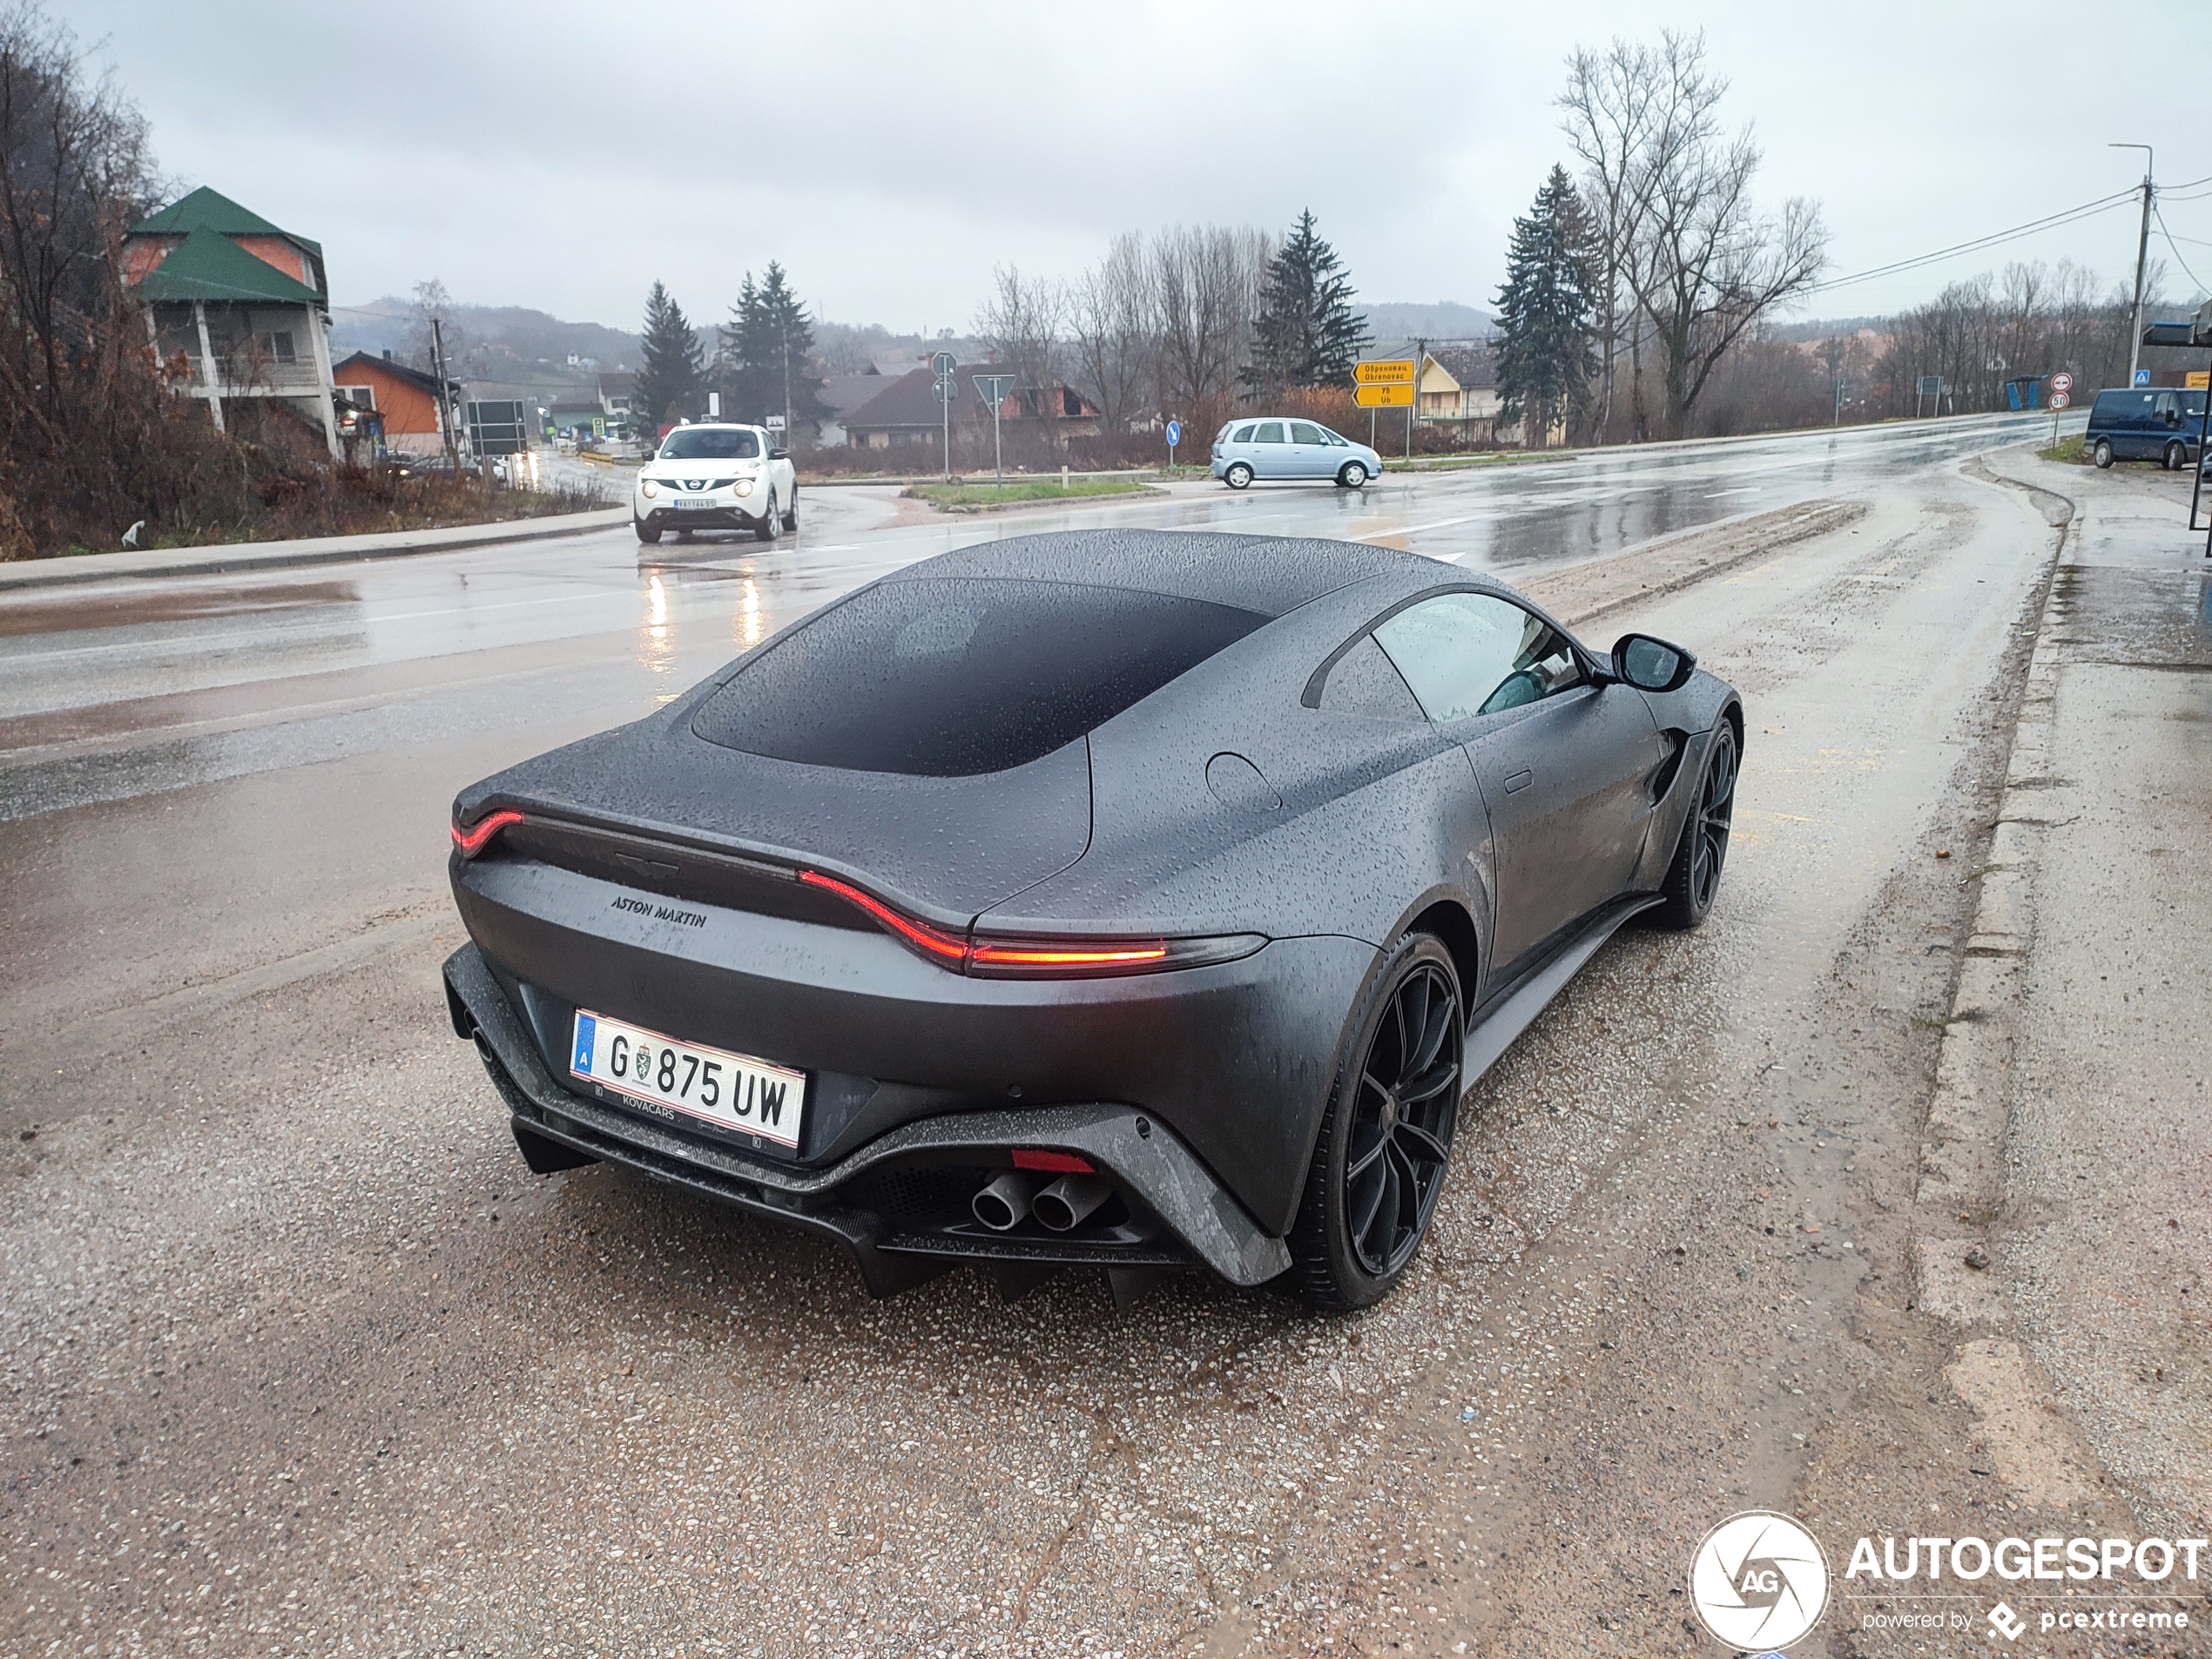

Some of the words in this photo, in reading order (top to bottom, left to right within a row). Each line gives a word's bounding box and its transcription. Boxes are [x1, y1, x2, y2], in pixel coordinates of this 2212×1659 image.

[1365, 365, 1407, 374] Обреновац
[2053, 396, 2066, 406] 50
[610, 896, 653, 916] ASTON
[654, 906, 707, 928] MARTIN
[579, 1051, 588, 1067] A
[610, 1035, 629, 1077] G
[657, 1048, 722, 1107] 875
[733, 1069, 786, 1127] UW
[623, 1095, 675, 1120] KOVACARS
